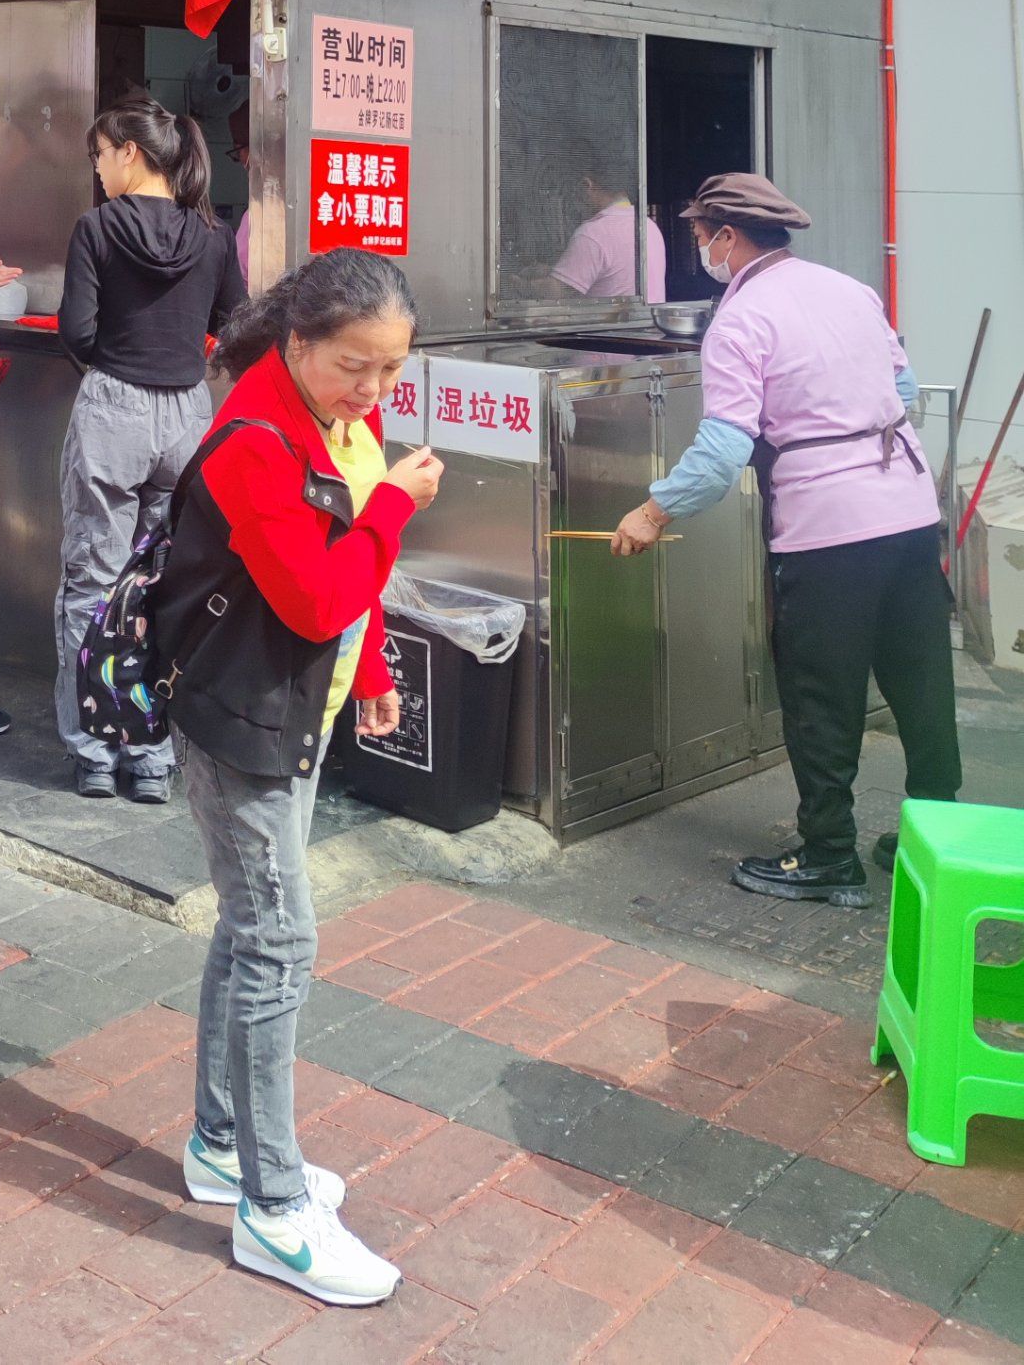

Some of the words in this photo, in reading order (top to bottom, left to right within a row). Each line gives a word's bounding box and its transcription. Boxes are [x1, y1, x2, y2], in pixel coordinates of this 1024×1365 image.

[321, 27, 407, 69] 营业时间
[358, 109, 406, 130] 金牌罗记肠旺面
[327, 153, 397, 188] 温馨提示
[317, 191, 404, 228] 拿小票取面
[436, 385, 532, 434] 湿垃圾
